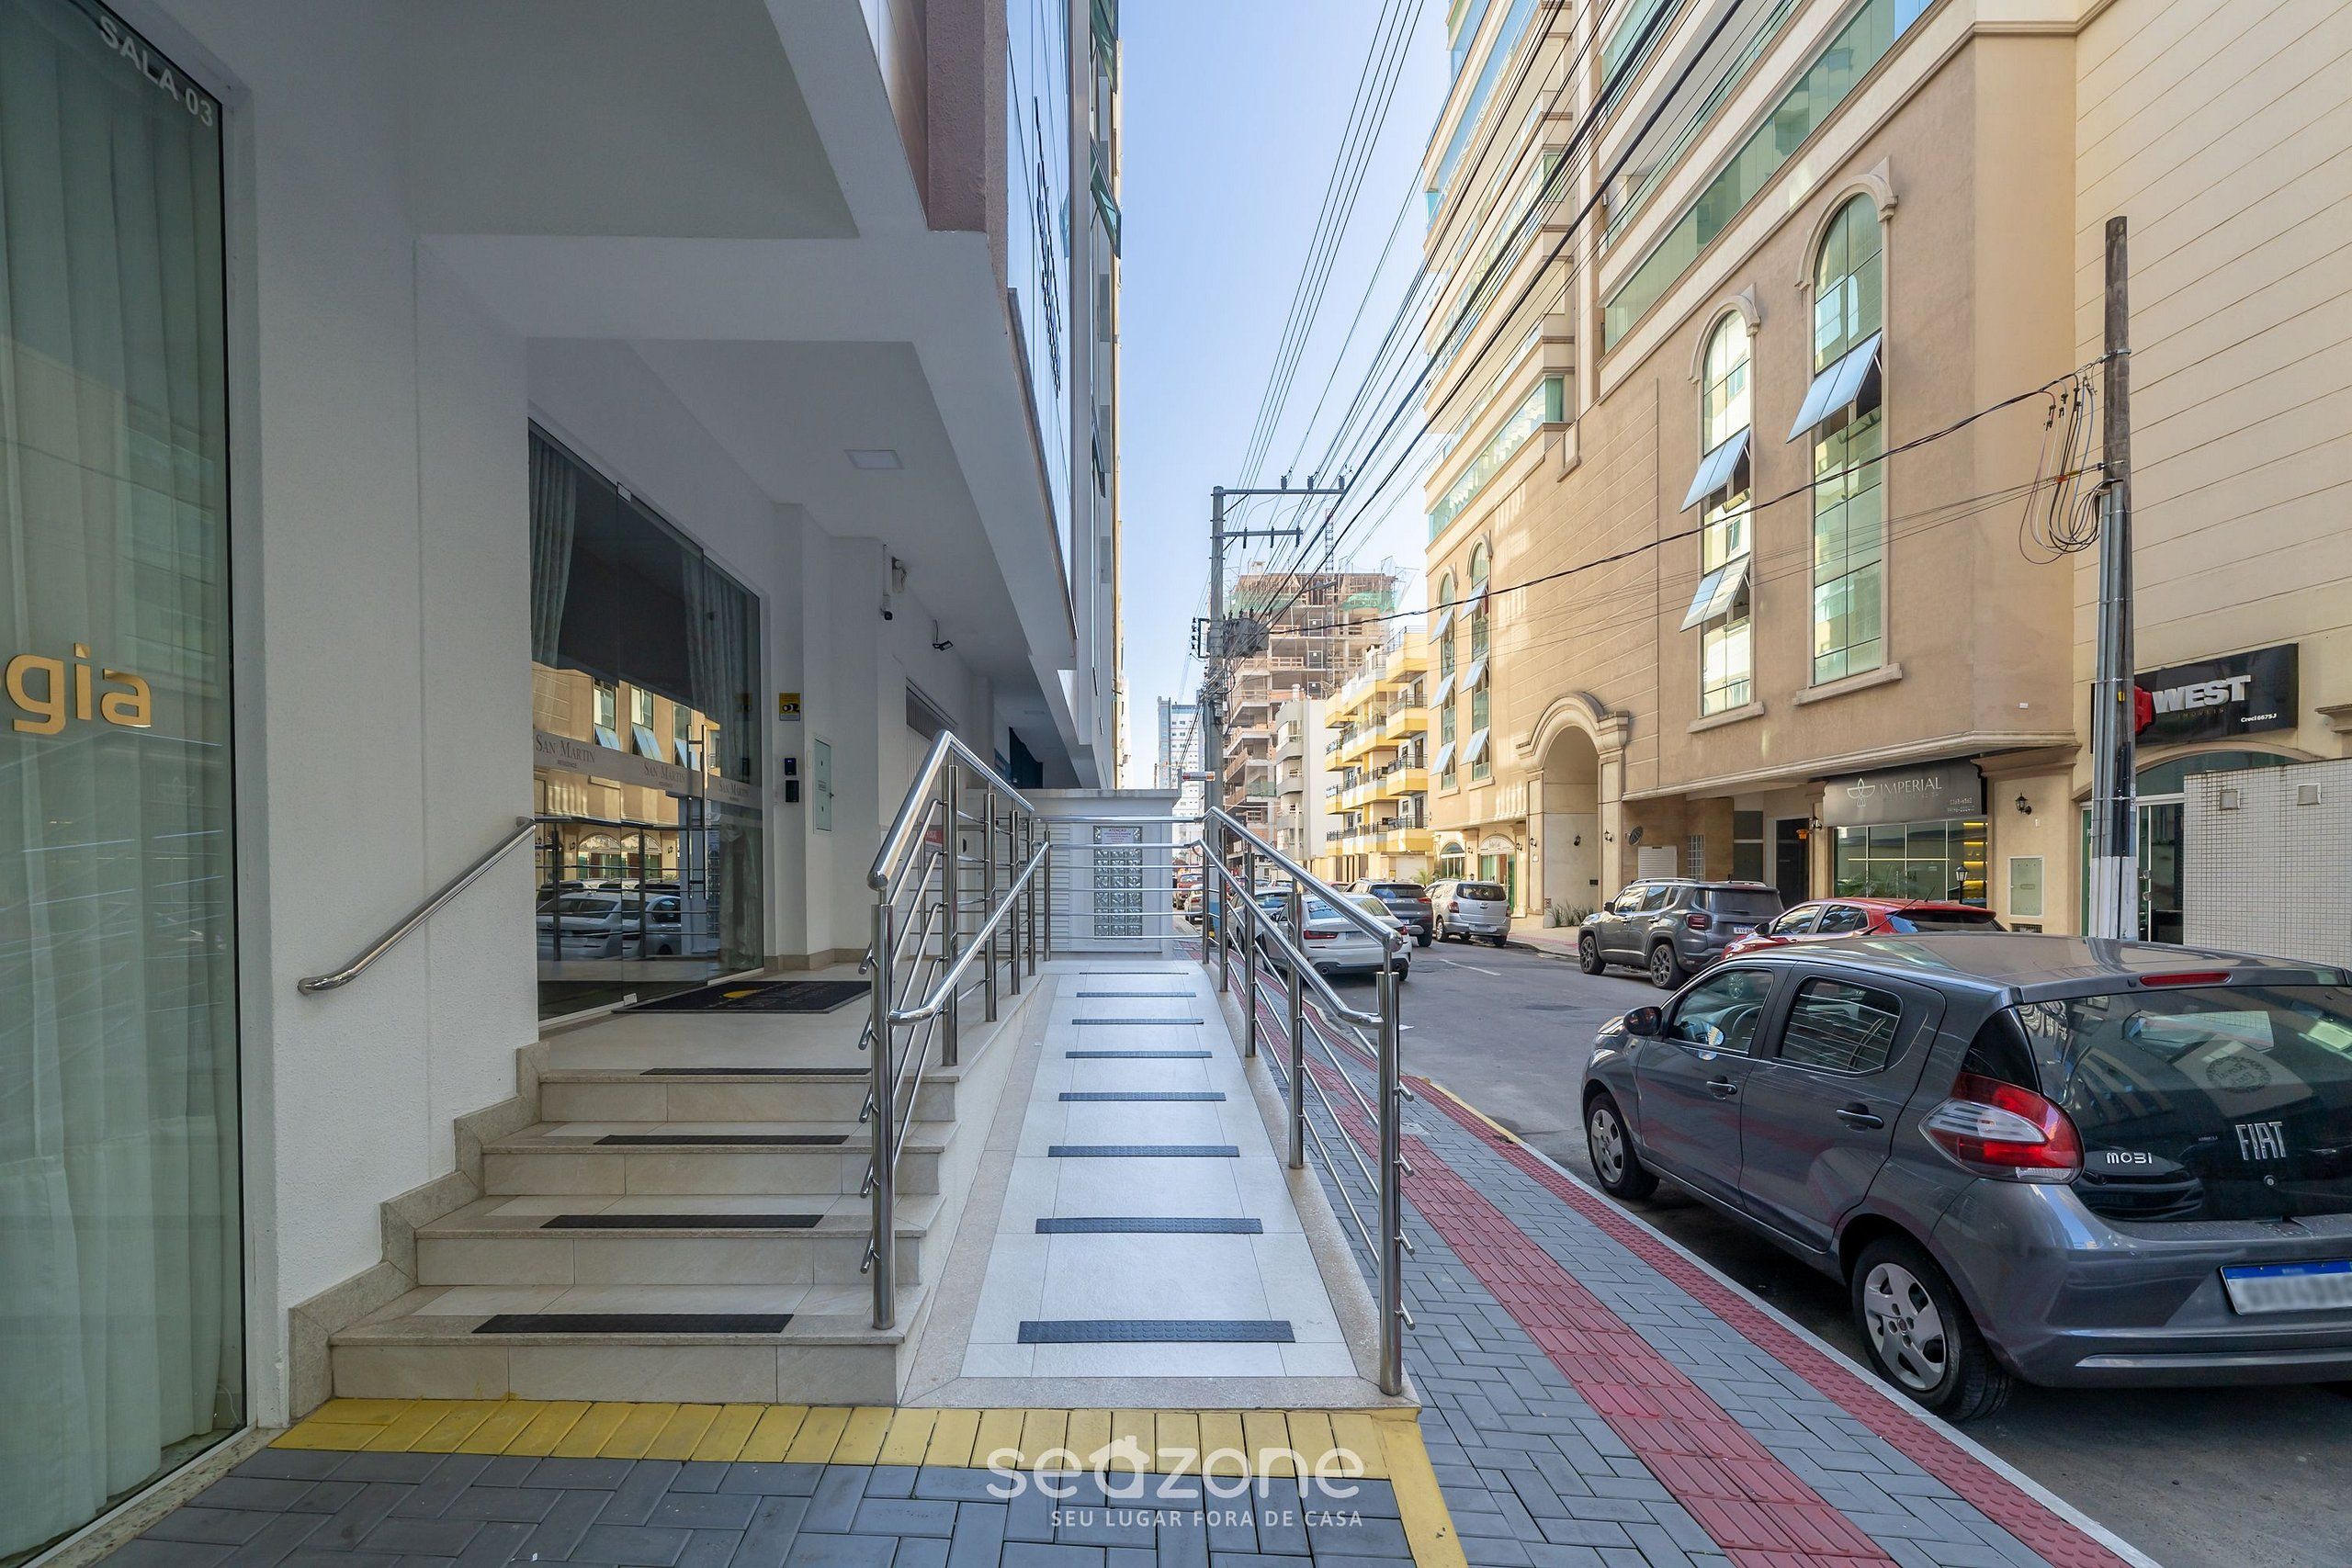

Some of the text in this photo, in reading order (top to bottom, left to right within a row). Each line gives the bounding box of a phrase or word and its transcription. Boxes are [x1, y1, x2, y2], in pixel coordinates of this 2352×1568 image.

[100, 16, 213, 126] SALA 03
[6, 643, 152, 735] gia
[2152, 674, 2251, 714] WEST
[536, 734, 595, 763] SAN MARTIN
[1880, 777, 1942, 795] IMPERIAL
[2107, 1152, 2152, 1164] MOBI
[2235, 1122, 2287, 1161] FIAT
